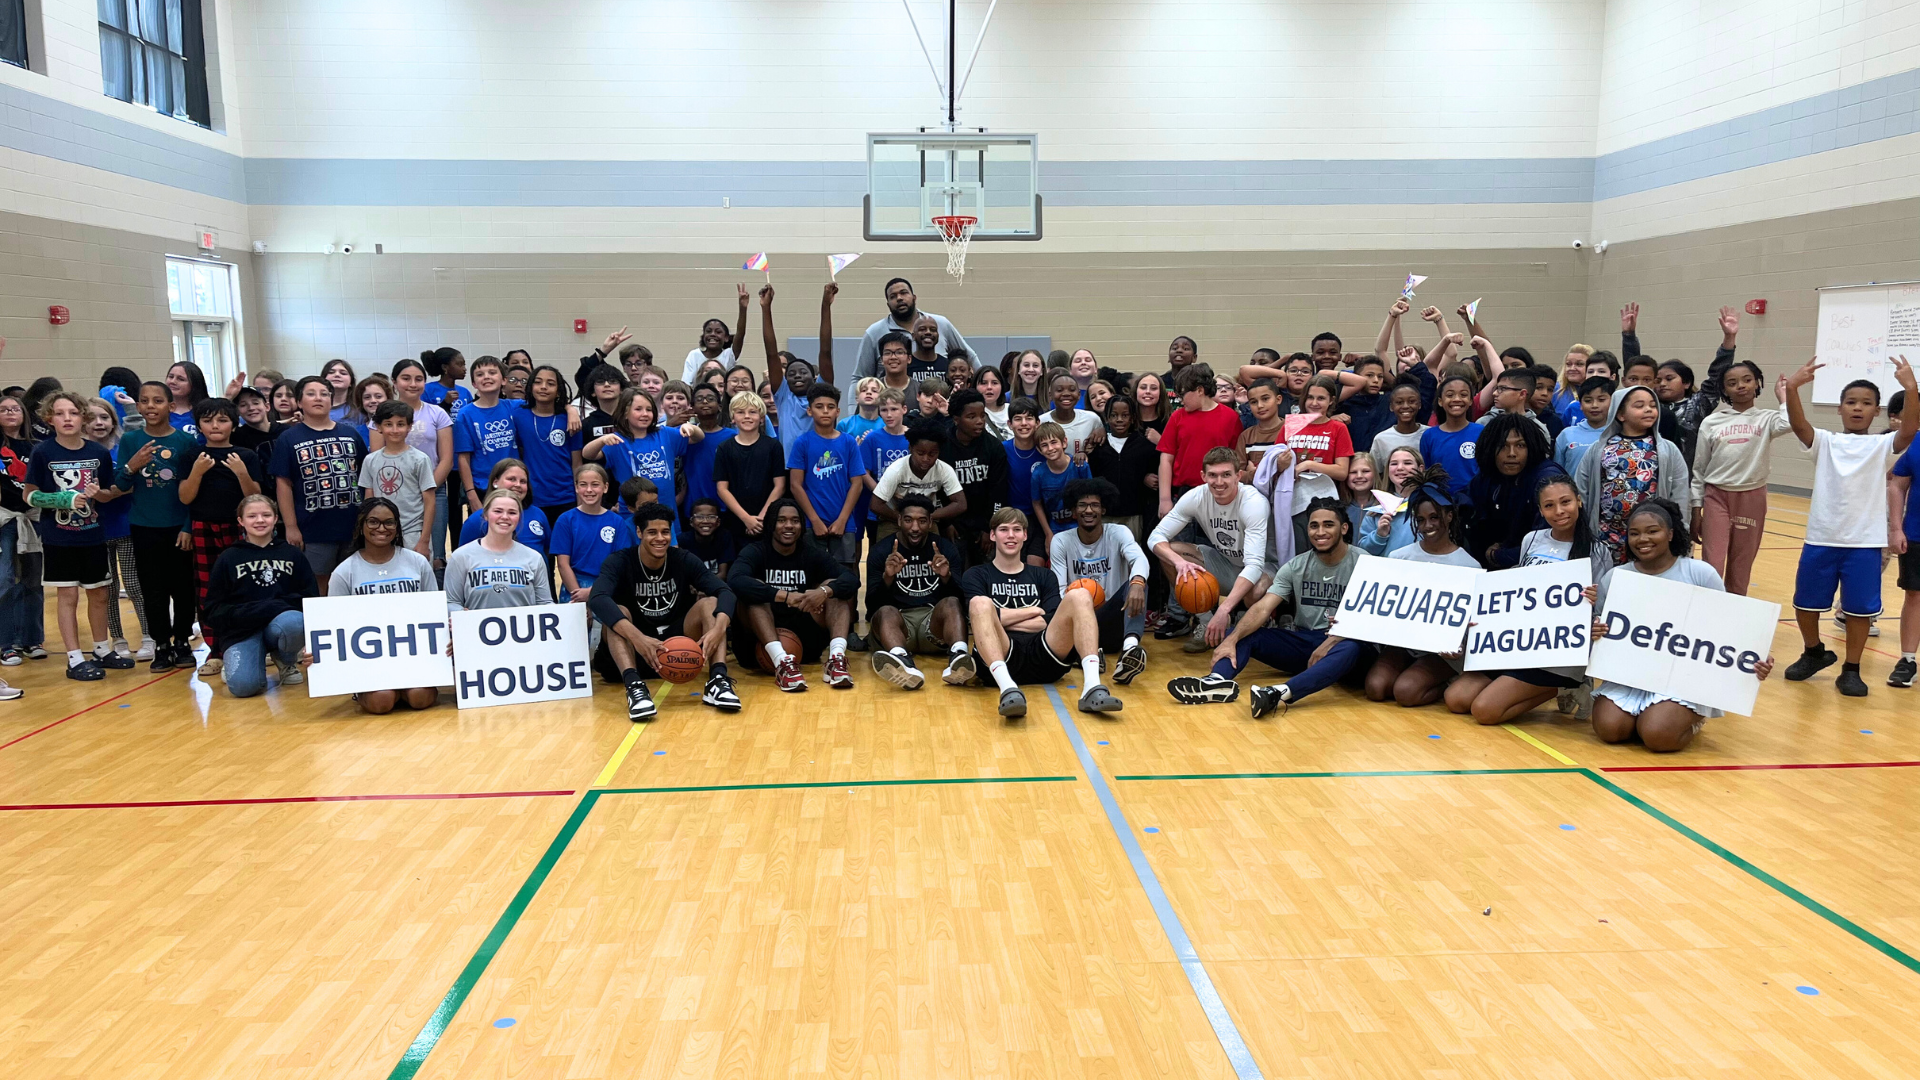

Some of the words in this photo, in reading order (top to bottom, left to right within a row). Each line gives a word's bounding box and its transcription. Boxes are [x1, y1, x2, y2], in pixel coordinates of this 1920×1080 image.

[1715, 424, 1763, 440] CALIFORNIA
[294, 440, 314, 449] SUPER
[1288, 435, 1330, 450] GEORGIA
[641, 466, 665, 475] OLYMPIC
[955, 460, 971, 468] MADE
[956, 464, 989, 484] ONEY
[235, 560, 294, 579] EVANS
[1073, 559, 1087, 575] WE
[1087, 563, 1101, 574] ARE
[468, 569, 489, 587] WE
[491, 571, 508, 582] ARE
[510, 569, 530, 586] ONE
[355, 584, 376, 596] WE
[379, 583, 397, 594] ARE
[635, 578, 677, 597] AUGUSTA
[992, 583, 1039, 596] AUGUSTA
[1302, 580, 1346, 600] PELICAN
[1344, 580, 1471, 627] JAGUARS
[1477, 587, 1537, 615] LET'S
[1544, 582, 1584, 608] GO
[643, 609, 670, 617] BASKETBALL
[478, 613, 562, 646] OUR
[310, 622, 445, 664] FIGHT
[1469, 624, 1586, 654] JAGUARS
[1603, 611, 1760, 674] Defense
[667, 655, 700, 666] SPALDING
[459, 660, 587, 700] HOUSE
